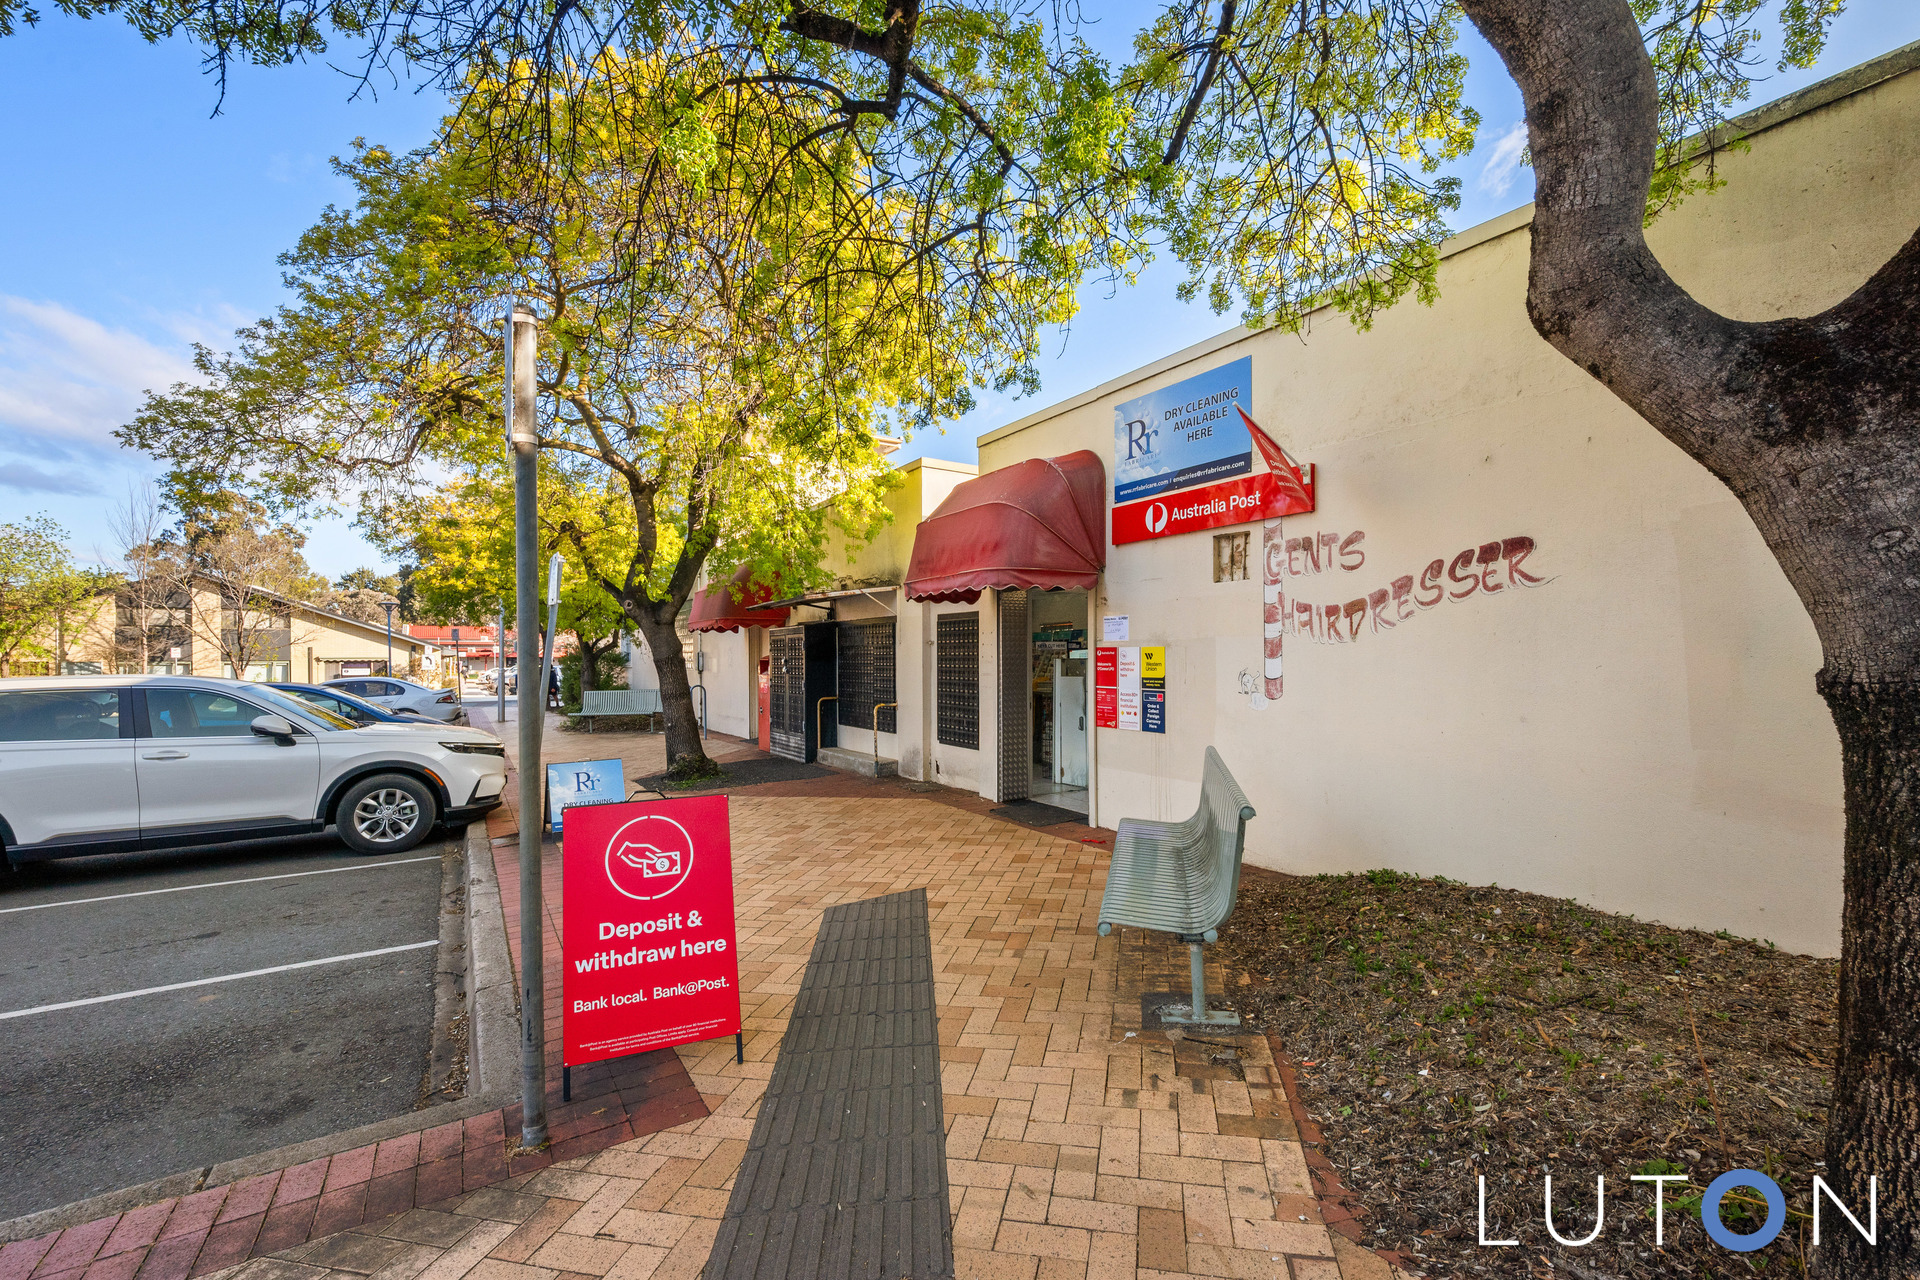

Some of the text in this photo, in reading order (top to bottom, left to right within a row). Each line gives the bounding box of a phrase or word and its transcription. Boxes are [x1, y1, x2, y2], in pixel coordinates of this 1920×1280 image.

[1164, 387, 1239, 421] DRY CLEANING
[1173, 405, 1228, 432] AVAILABLE
[1187, 425, 1213, 442] HERE
[1119, 480, 1169, 495] www.rrfabricare.com
[1172, 460, 1245, 483] enquiries@rrfabricare.com
[1171, 490, 1261, 521] Australia Post
[1264, 530, 1367, 581] GENTS
[1277, 535, 1548, 643] HAIRDRESSER
[599, 910, 703, 940] Deposit &
[574, 938, 727, 974] withdraw here
[573, 976, 730, 1013] Bank local. Bank@Post.
